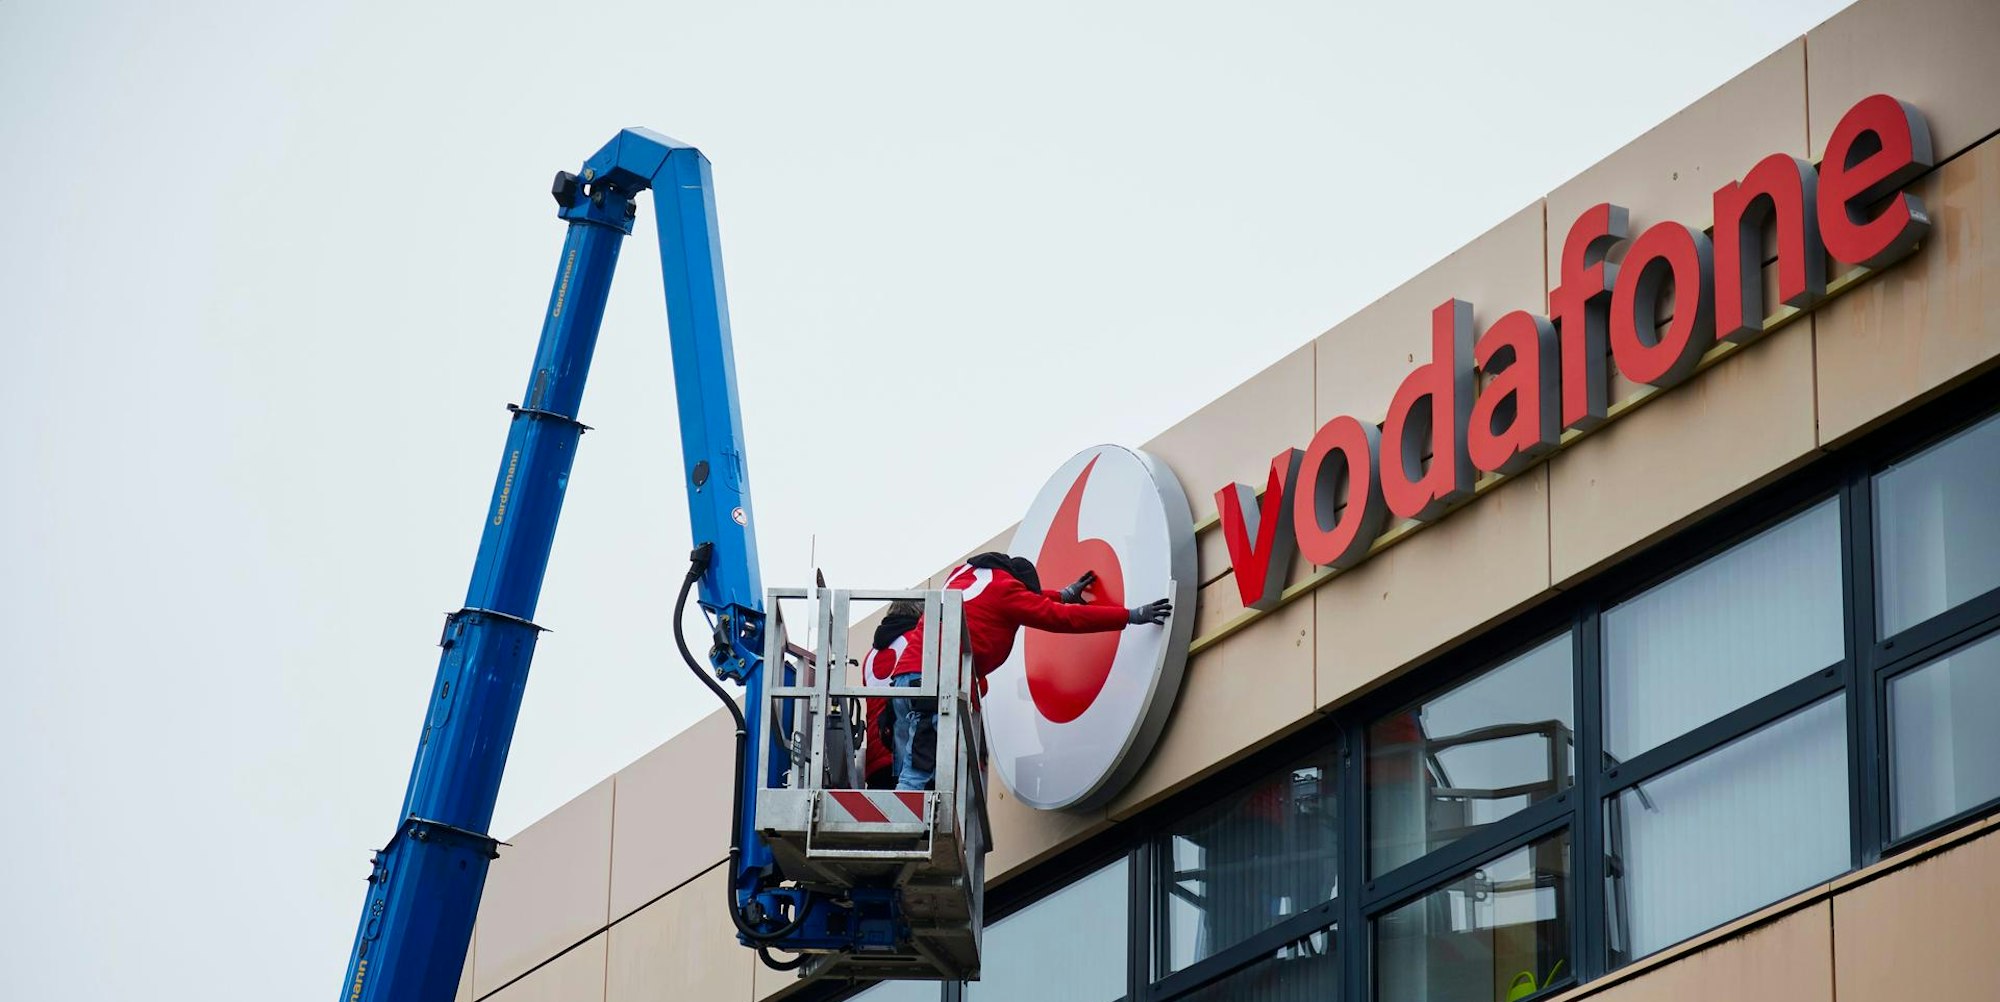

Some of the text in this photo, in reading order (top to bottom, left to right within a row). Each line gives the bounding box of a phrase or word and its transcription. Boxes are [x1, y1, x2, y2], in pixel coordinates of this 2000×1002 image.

[553, 249, 576, 317] Gardemann
[1214, 93, 1932, 609] vodafone
[493, 450, 519, 526] Gardemann
